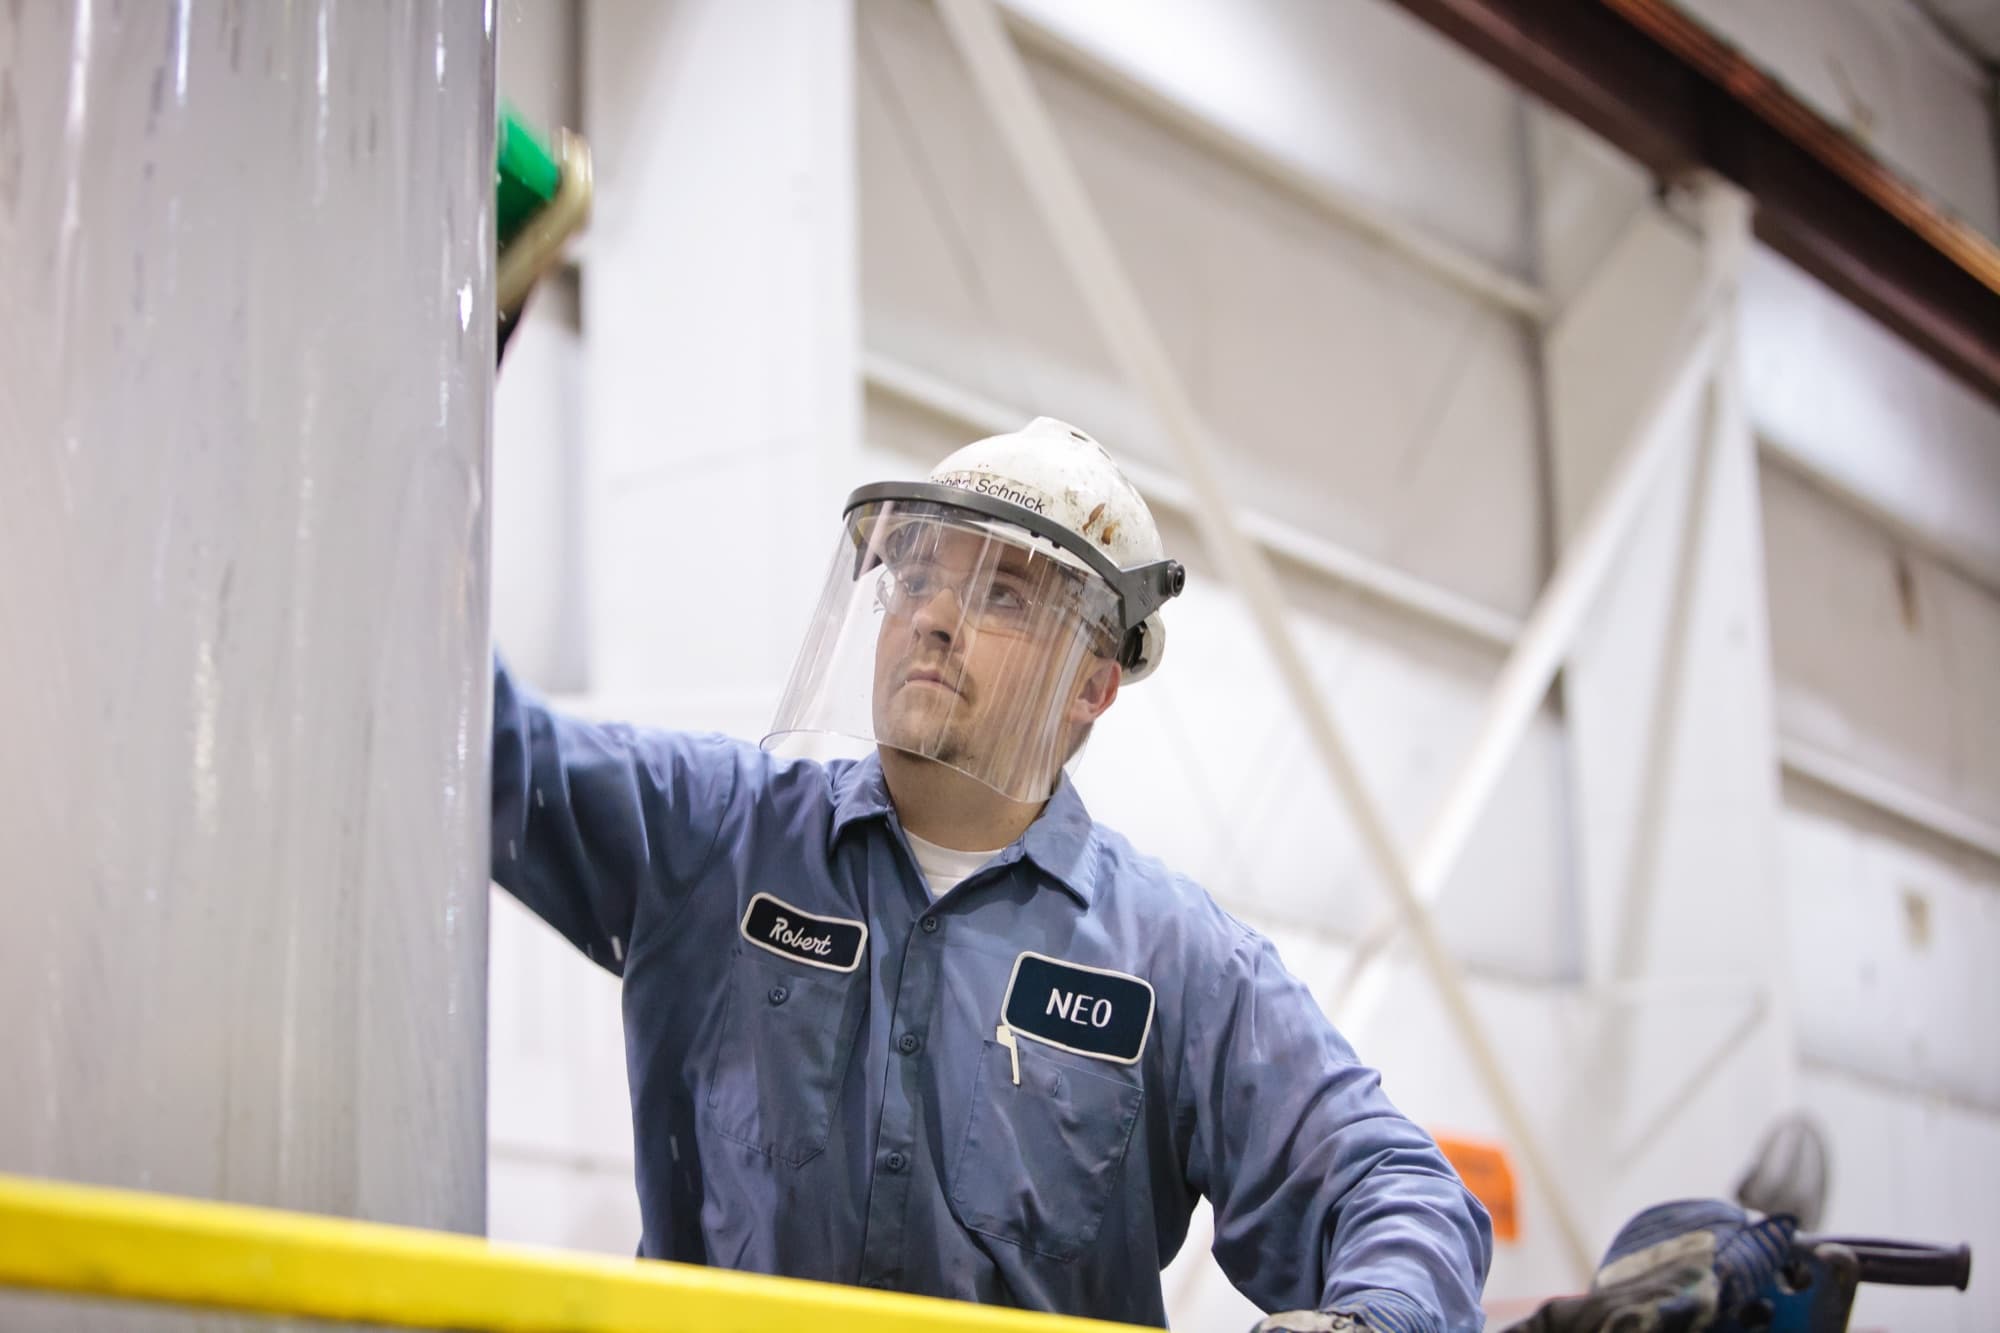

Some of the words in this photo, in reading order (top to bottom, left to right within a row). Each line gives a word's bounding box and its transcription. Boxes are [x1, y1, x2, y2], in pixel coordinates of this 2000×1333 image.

[975, 478, 1046, 514] Schnick
[769, 917, 832, 955] Robert
[1045, 987, 1112, 1028] NEO
